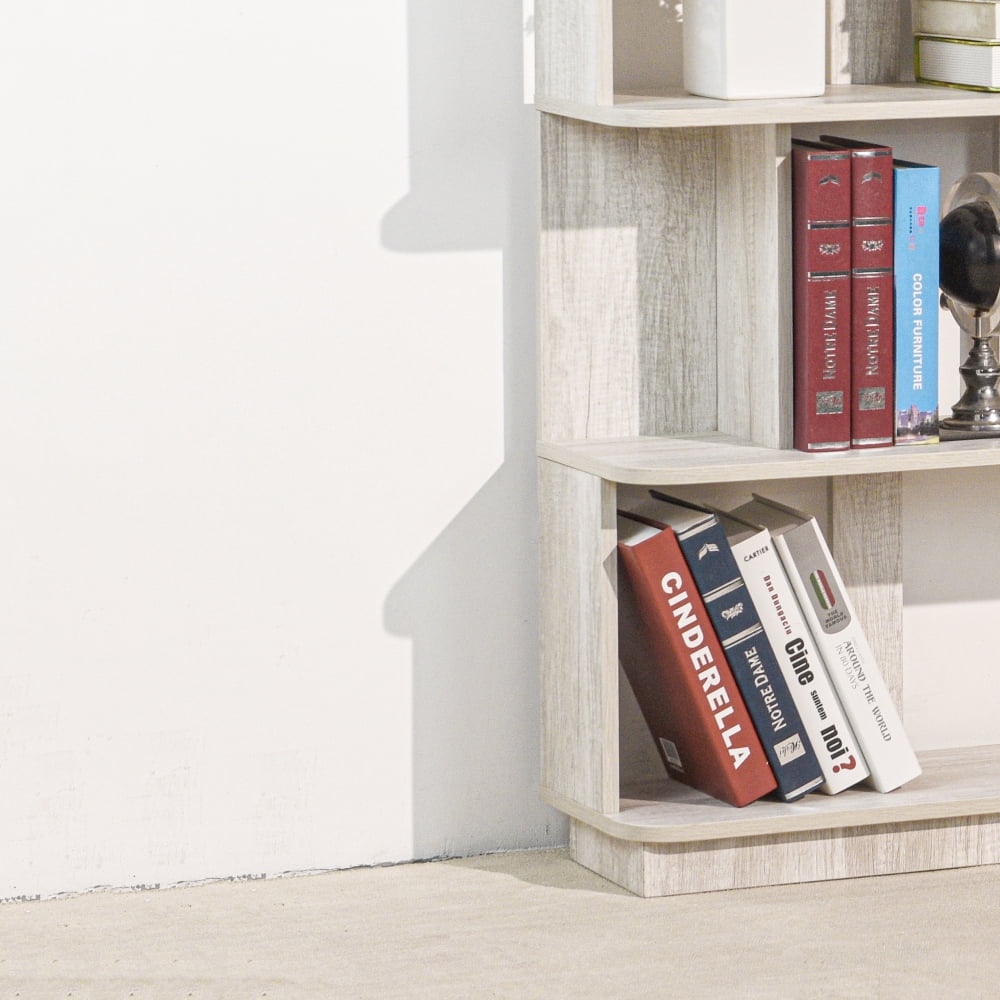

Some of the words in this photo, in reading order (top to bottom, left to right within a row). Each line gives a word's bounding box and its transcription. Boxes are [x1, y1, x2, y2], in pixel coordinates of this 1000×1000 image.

[822, 289, 837, 331] DAME
[865, 286, 880, 328] DAME
[912, 273, 923, 316] COLOR
[822, 331, 838, 381] NOTRE
[865, 328, 880, 377] NOTRE
[912, 320, 923, 391] FURNITURE
[743, 545, 769, 562] CARTIER
[763, 575, 775, 593] Dan
[771, 593, 793, 636] Dungaciu
[825, 611, 844, 624] WORLD
[825, 615, 848, 629] FAMOUS
[660, 571, 751, 770] CINDERELLA
[744, 645, 769, 688] DAME
[760, 685, 787, 733] NOTRE
[784, 637, 815, 686] Cine
[810, 689, 828, 721] suntem
[820, 724, 857, 774] noi?
[843, 640, 866, 682] AROUND
[862, 684, 876, 705] THE
[872, 705, 892, 742] WORLD
